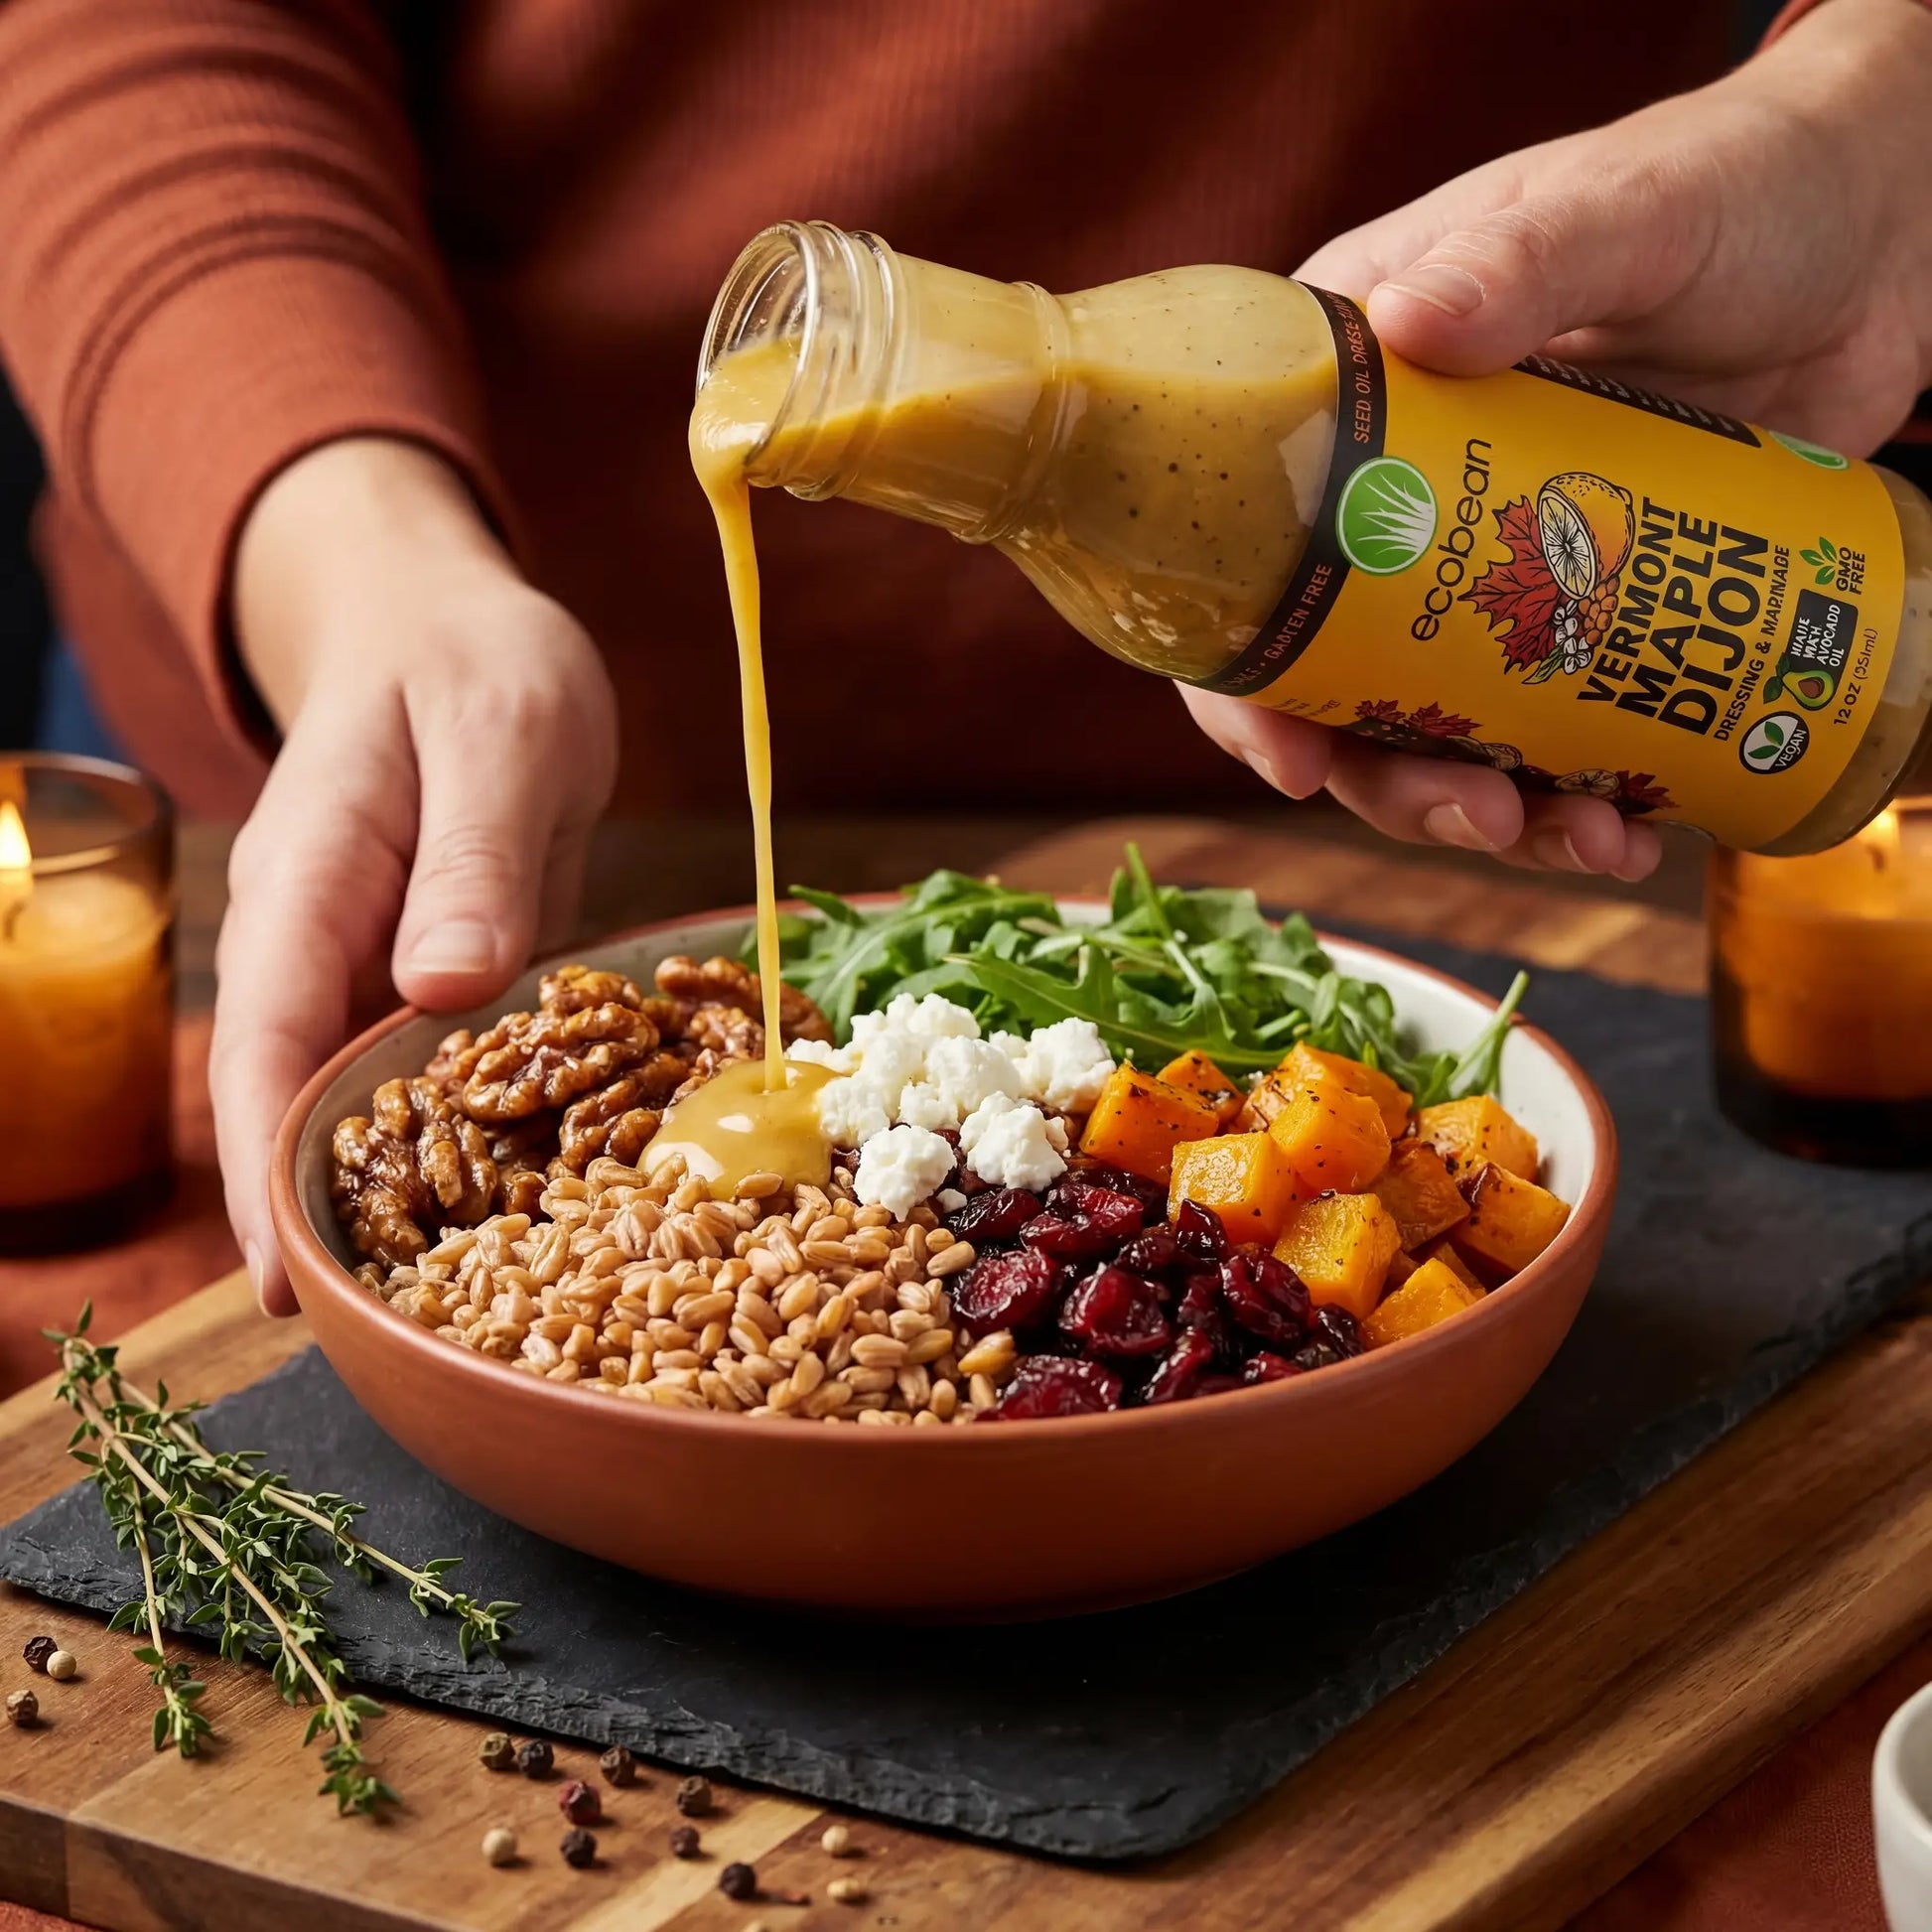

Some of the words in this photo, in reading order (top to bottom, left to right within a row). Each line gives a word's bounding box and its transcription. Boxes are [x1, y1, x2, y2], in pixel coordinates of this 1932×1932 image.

[1355, 371, 1371, 395] OIL
[1354, 400, 1372, 444] SEED
[1411, 438, 1491, 641] ecobean
[1302, 564, 1332, 605] FREE
[1836, 547, 1852, 592] GMO
[1850, 553, 1865, 596] FREE
[1576, 496, 1676, 702] VERMONT
[1615, 511, 1718, 718] MAPLE
[1657, 525, 1768, 736] DIJON
[1829, 648, 1845, 667] OIL
[1714, 659, 1764, 741] DRESSING
[1755, 642, 1771, 655] &
[1834, 708, 1853, 725] 12
[1844, 682, 1863, 706] OZ
[1775, 729, 1808, 767] VEGAN
